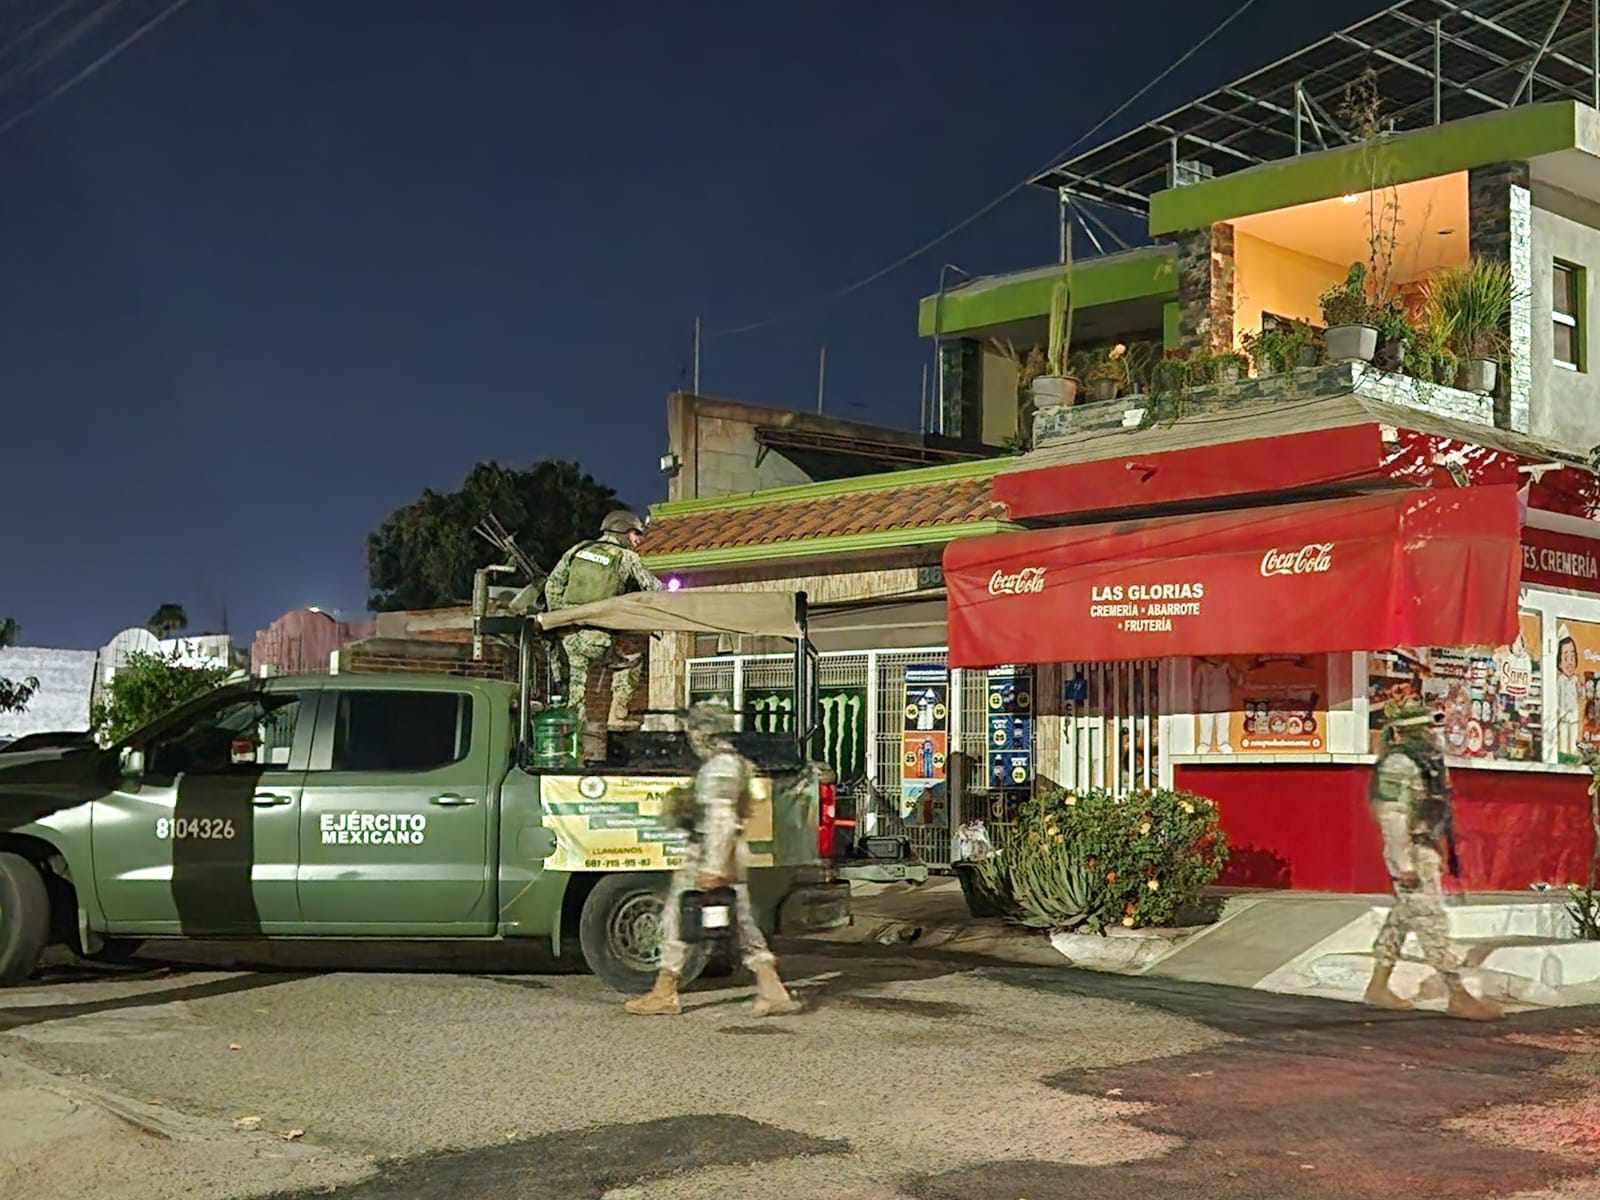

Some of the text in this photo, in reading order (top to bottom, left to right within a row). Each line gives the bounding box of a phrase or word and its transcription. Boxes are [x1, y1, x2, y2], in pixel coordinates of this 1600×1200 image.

[1261, 543, 1334, 576] Coca-Cola
[1540, 549, 1597, 579] CREMERÍA
[989, 567, 1047, 595] Coca-Cola
[1092, 583, 1204, 600] LAS GLORIAS
[1090, 601, 1200, 617] CREMERÍA ABARROTE
[1124, 616, 1172, 632] FRUTERÍA
[155, 817, 236, 840] 8104326
[320, 810, 426, 831] EJÉRCITO
[322, 831, 424, 845] MEXICANO
